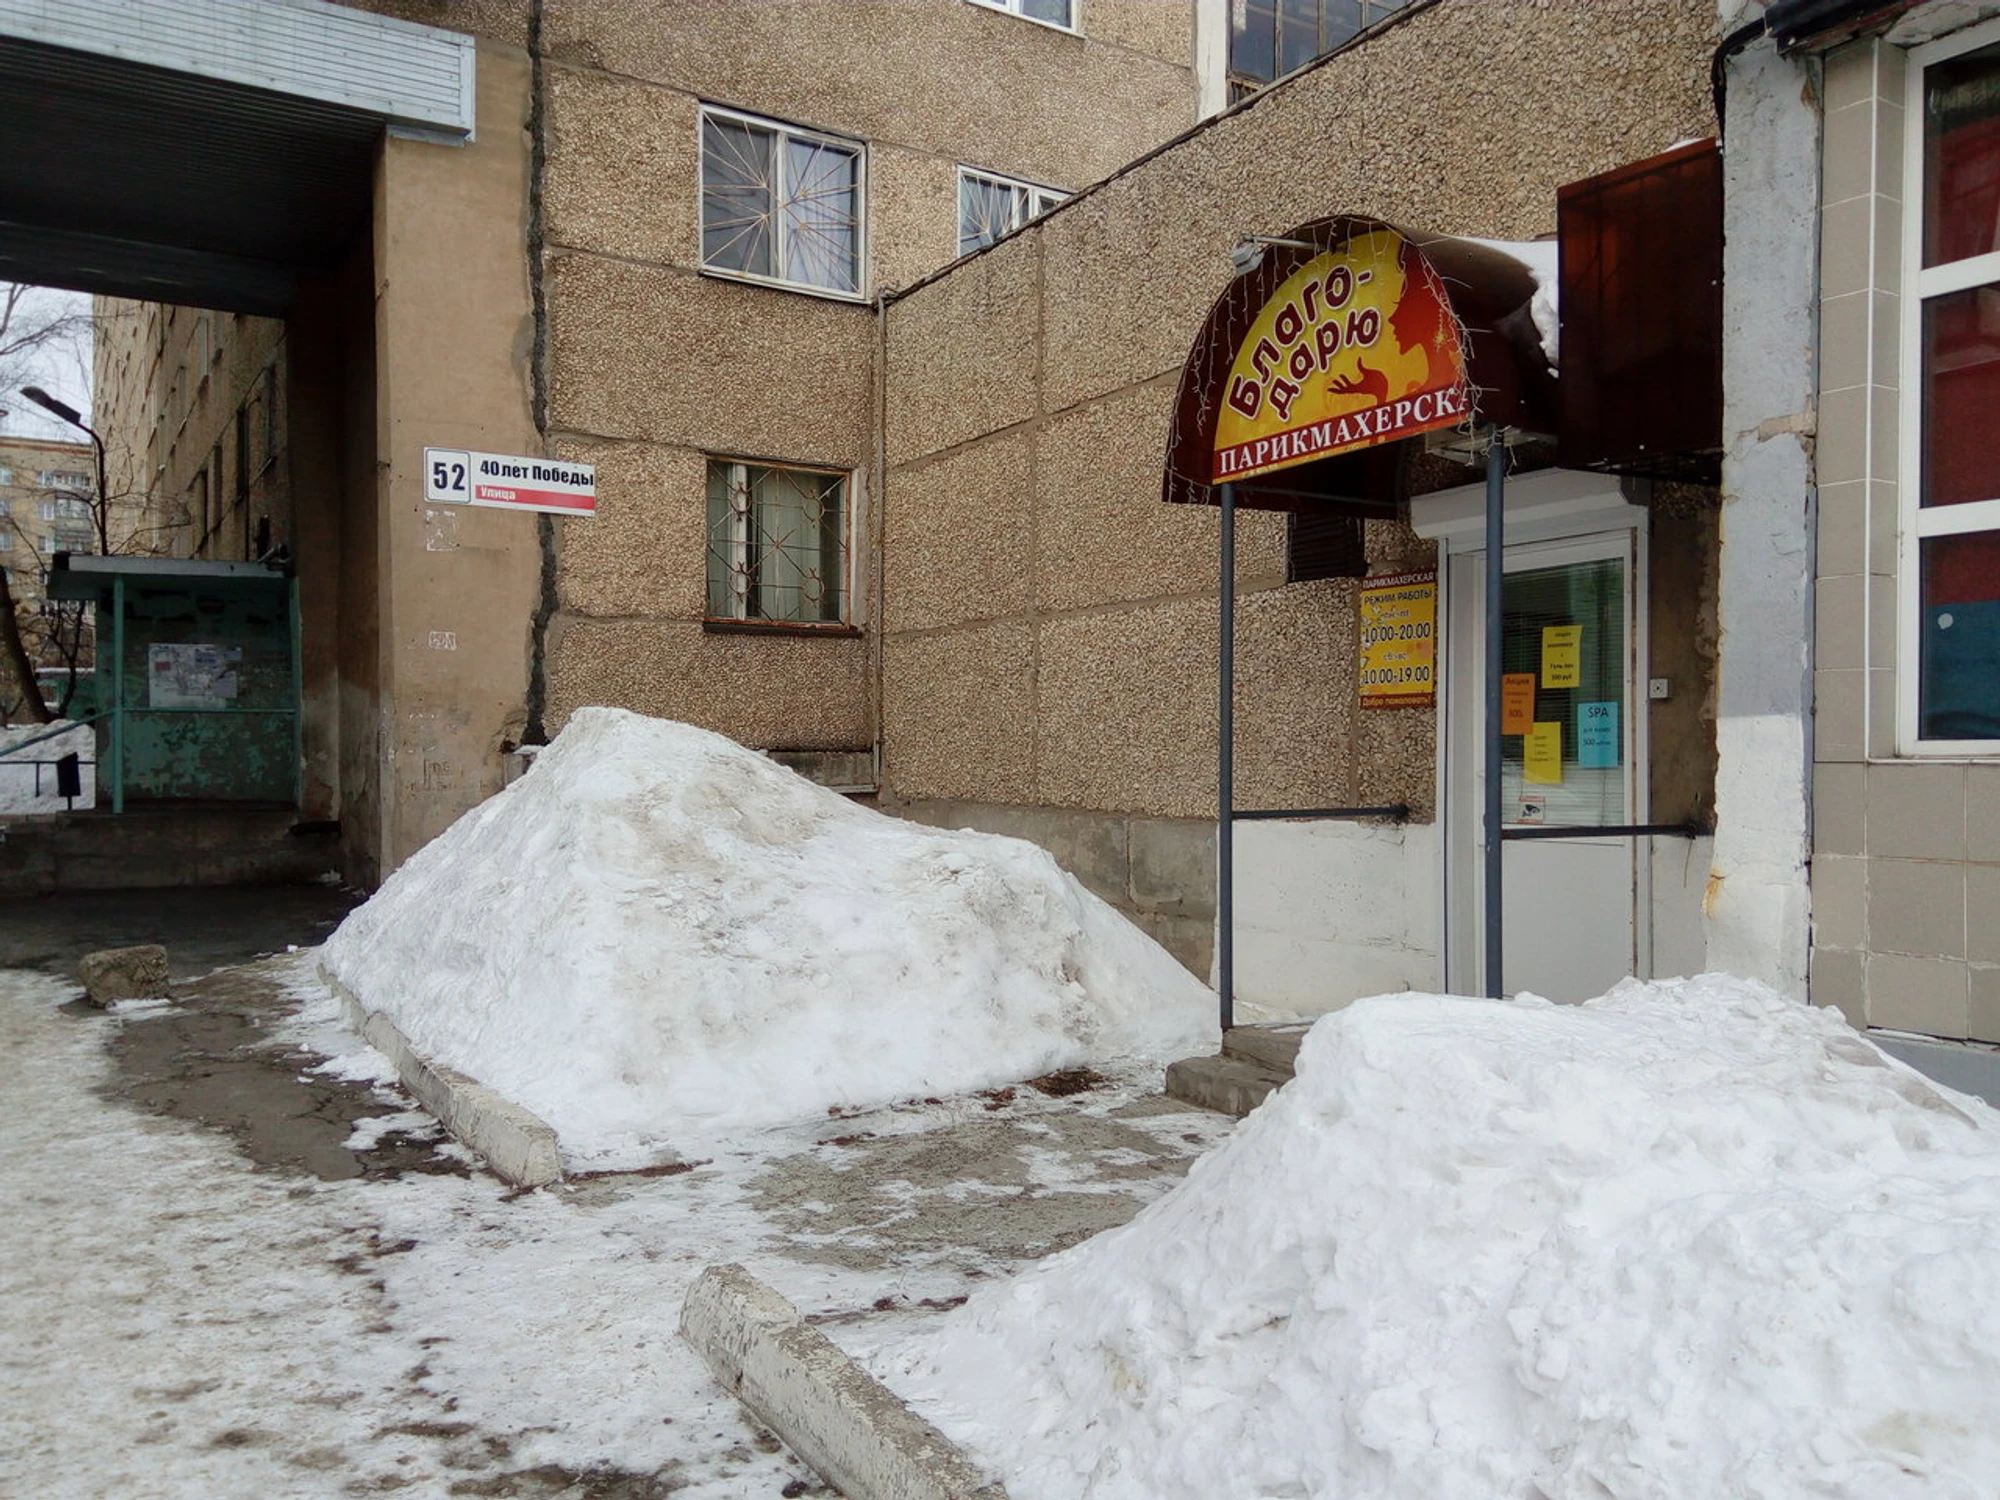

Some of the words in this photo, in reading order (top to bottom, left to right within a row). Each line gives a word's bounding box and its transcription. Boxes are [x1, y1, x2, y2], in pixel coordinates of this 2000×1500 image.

[433, 462, 466, 491] 52
[532, 465, 594, 486] Победы
[480, 486, 516, 501] Улица
[1362, 572, 1434, 589] ПАРИКМАХЕРСКАЯ
[1398, 589, 1432, 601] РАБОТЫ
[1588, 706, 1609, 719] SPA
